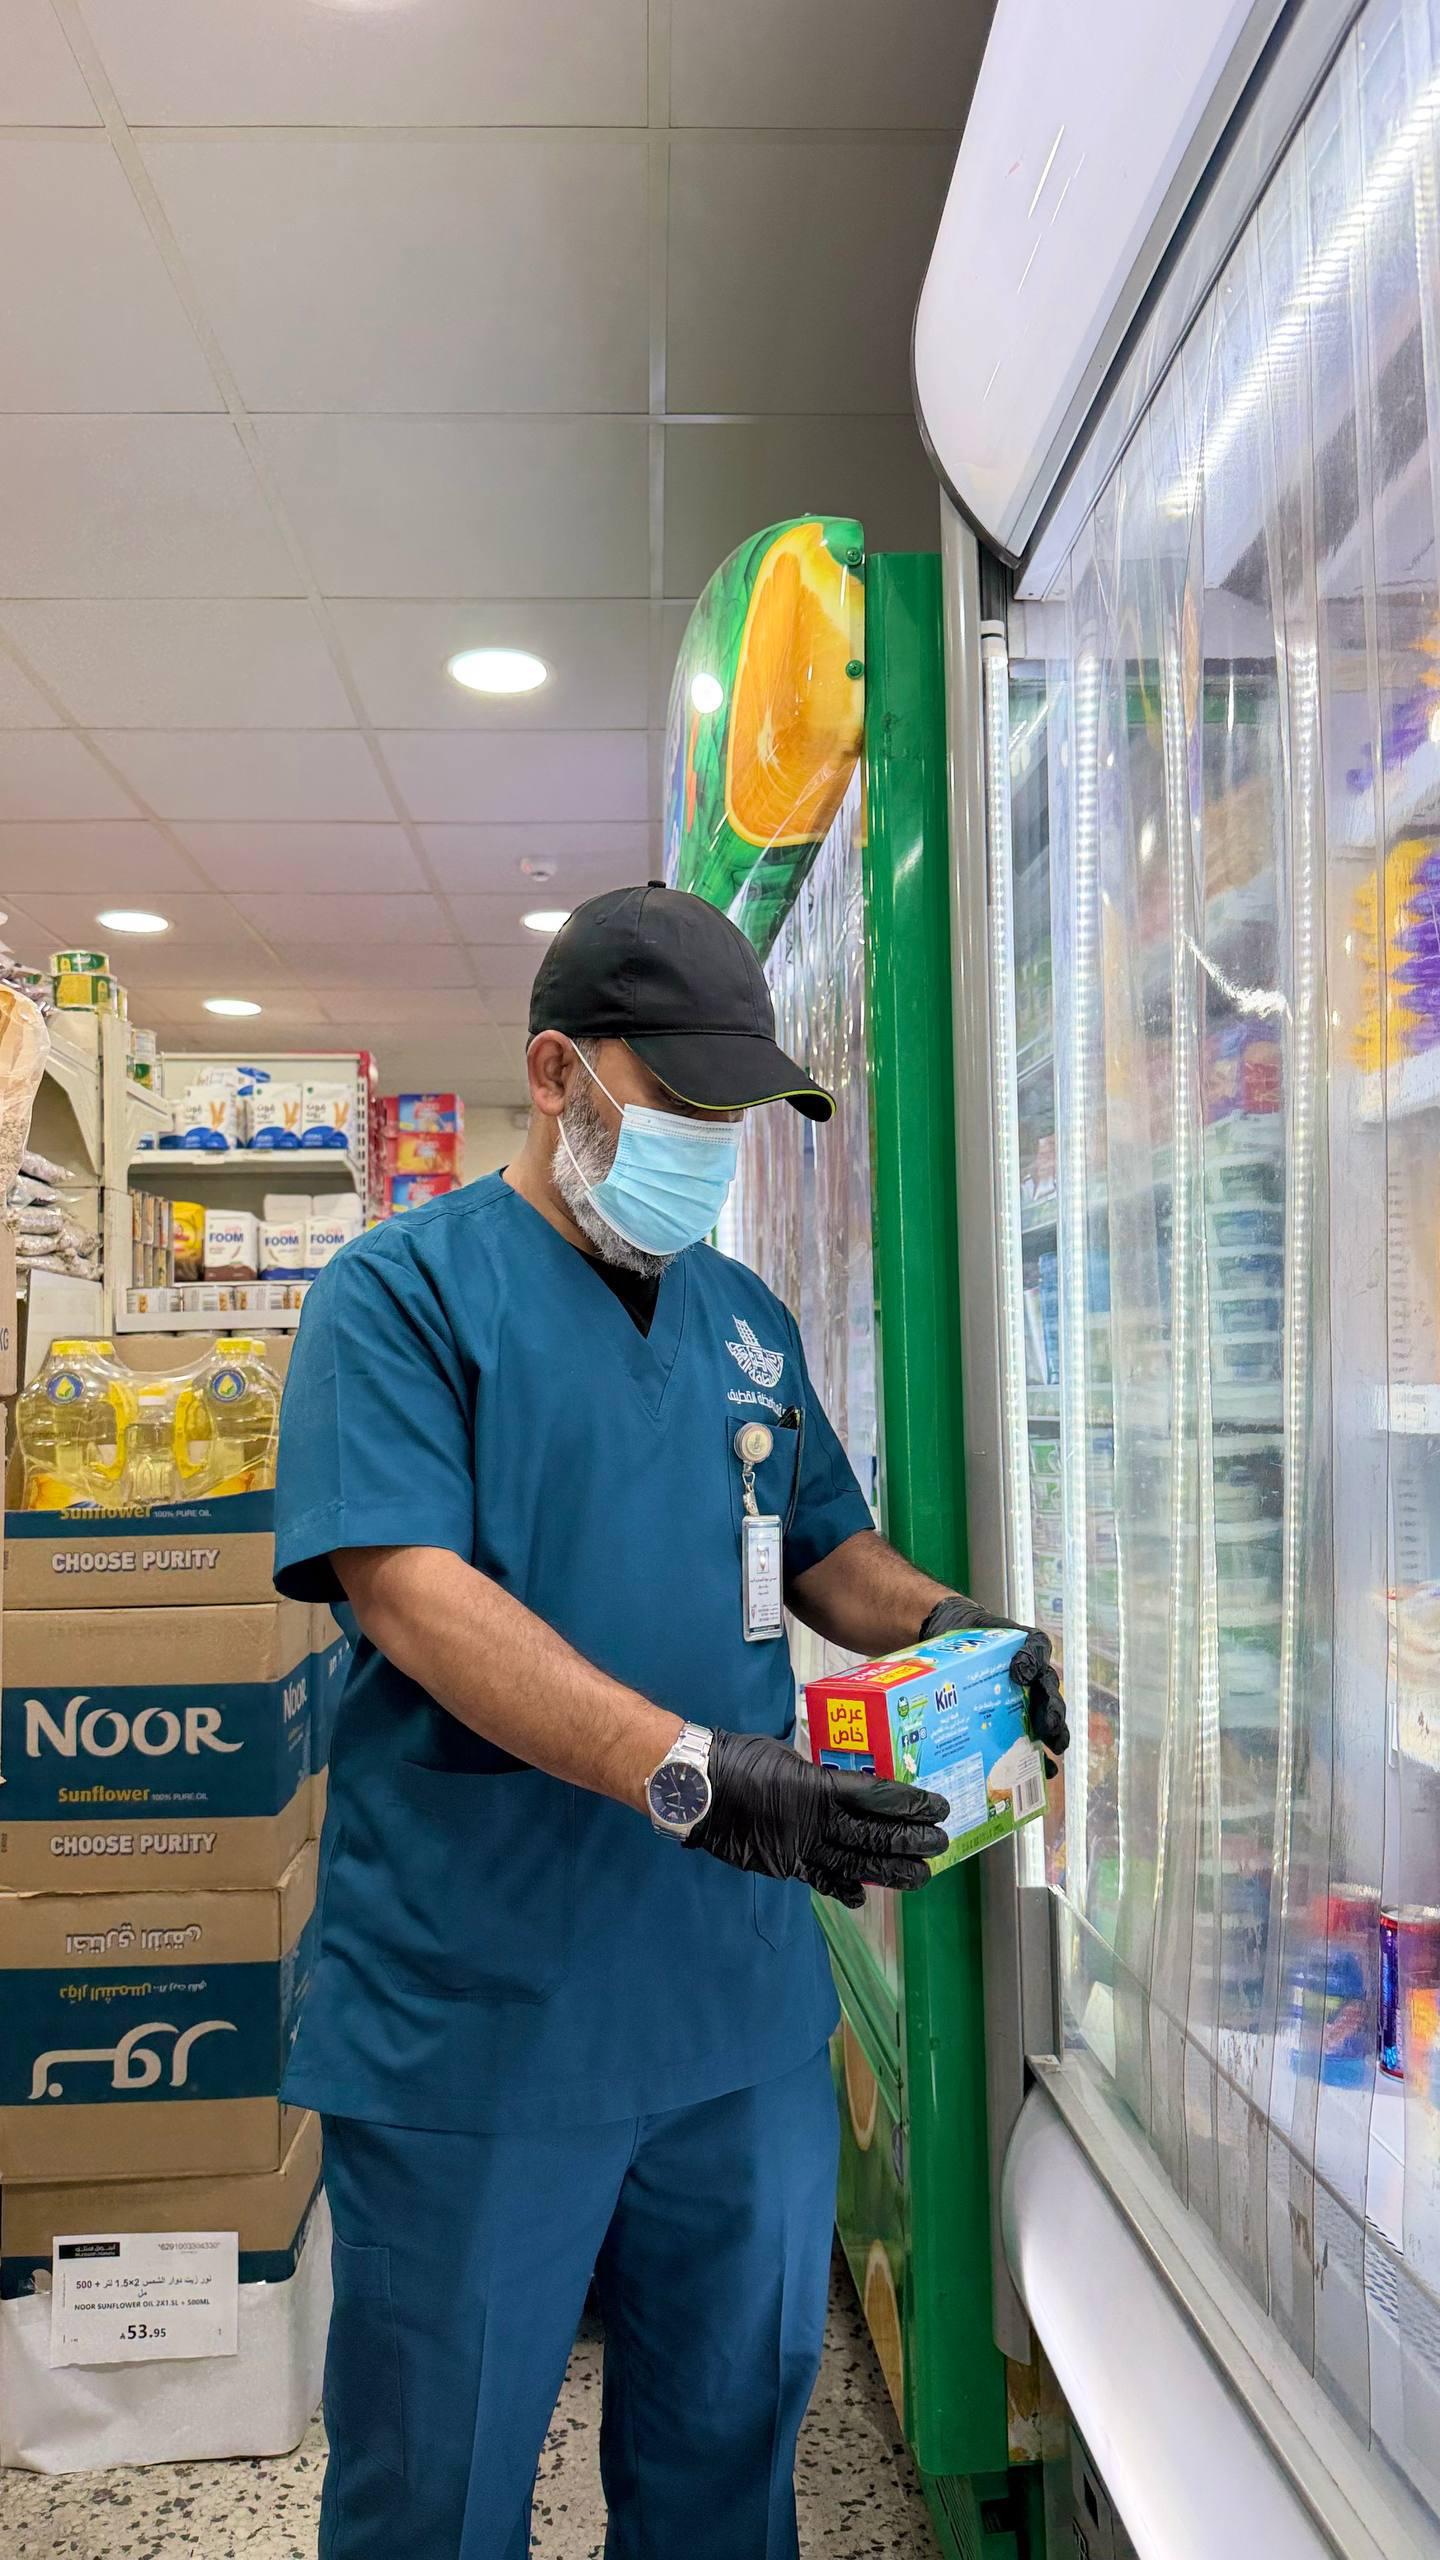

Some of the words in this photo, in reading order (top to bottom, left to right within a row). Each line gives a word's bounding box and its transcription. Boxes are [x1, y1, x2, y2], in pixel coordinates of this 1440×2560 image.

[209, 1232, 244, 1242] FOOM
[265, 1235, 299, 1246] FOOM
[310, 1234, 344, 1244] FOOM
[52, 1551, 136, 1573] CHOOSE
[142, 1548, 220, 1570] PURITY
[934, 1682, 959, 1712] Kiri
[830, 1702, 864, 1724] عرض
[833, 1725, 864, 1745] خاص
[58, 1785, 151, 1803] Sunflower
[50, 1834, 134, 1856] CHOOSE
[140, 1832, 217, 1854] PURITY
[66, 1922, 136, 1956] اختاري
[90, 1982, 152, 2004] الشمس
[28, 2020, 239, 2100] نور
[76, 2280, 93, 2289] 500
[74, 2303, 96, 2311] NOOR
[97, 2301, 141, 2310] SUNFLOWER
[187, 2298, 210, 2306] 500ML
[127, 2324, 167, 2340] 53.95
